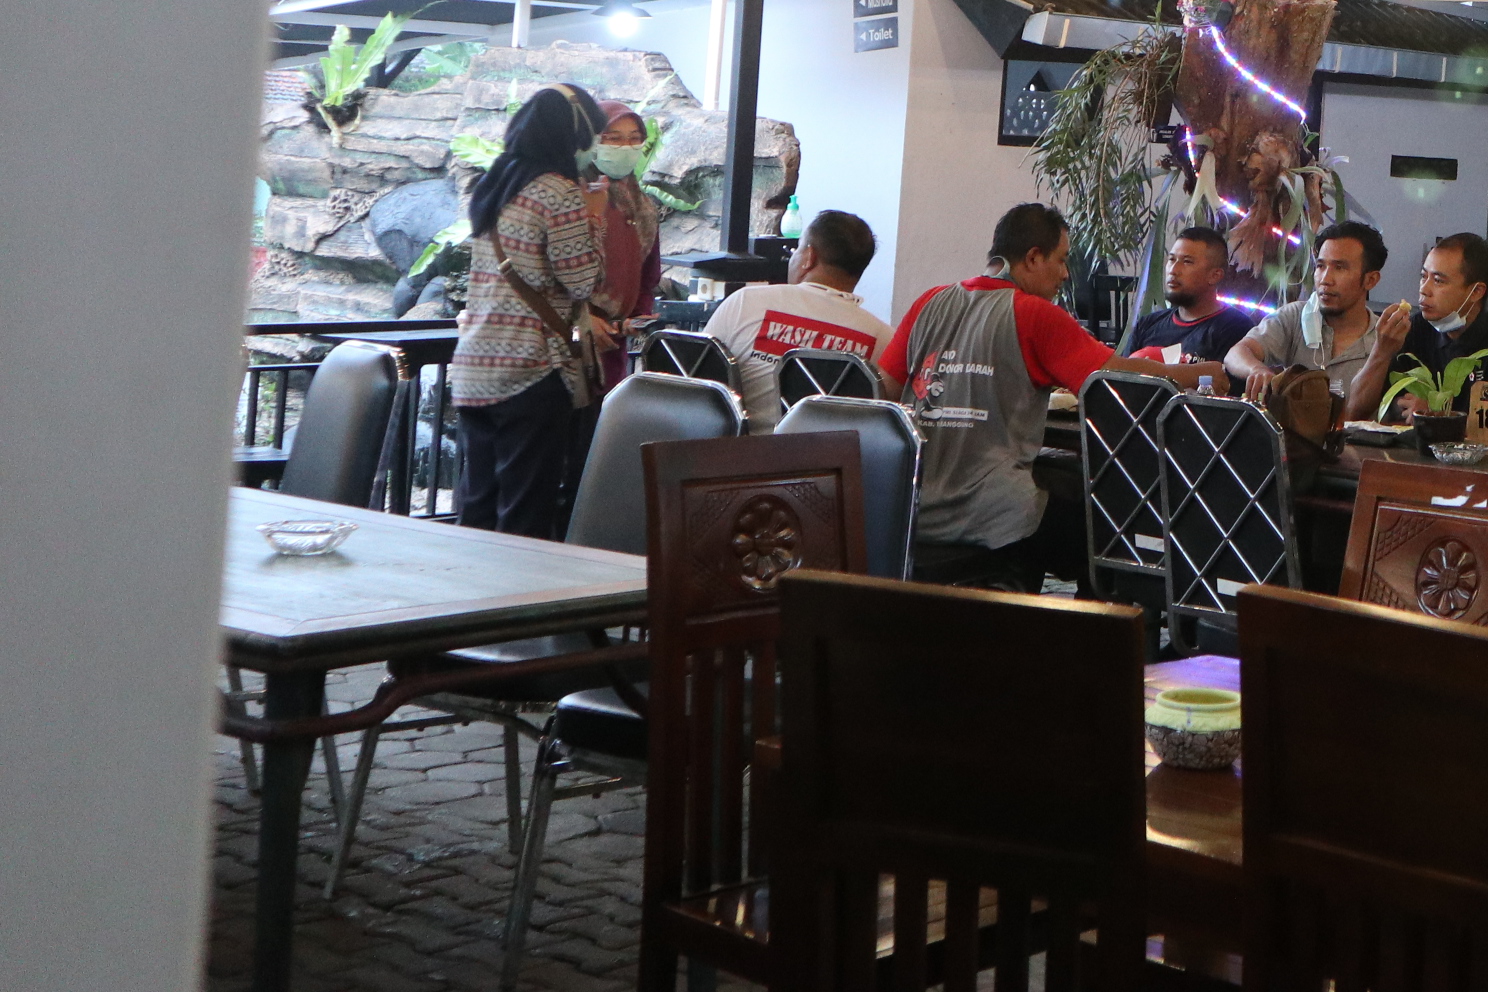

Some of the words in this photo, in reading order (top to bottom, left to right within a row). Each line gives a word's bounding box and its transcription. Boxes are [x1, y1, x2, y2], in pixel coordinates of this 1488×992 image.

[868, 28, 893, 42] Toilet
[766, 321, 819, 349] WASH
[821, 334, 869, 356] TEAM
